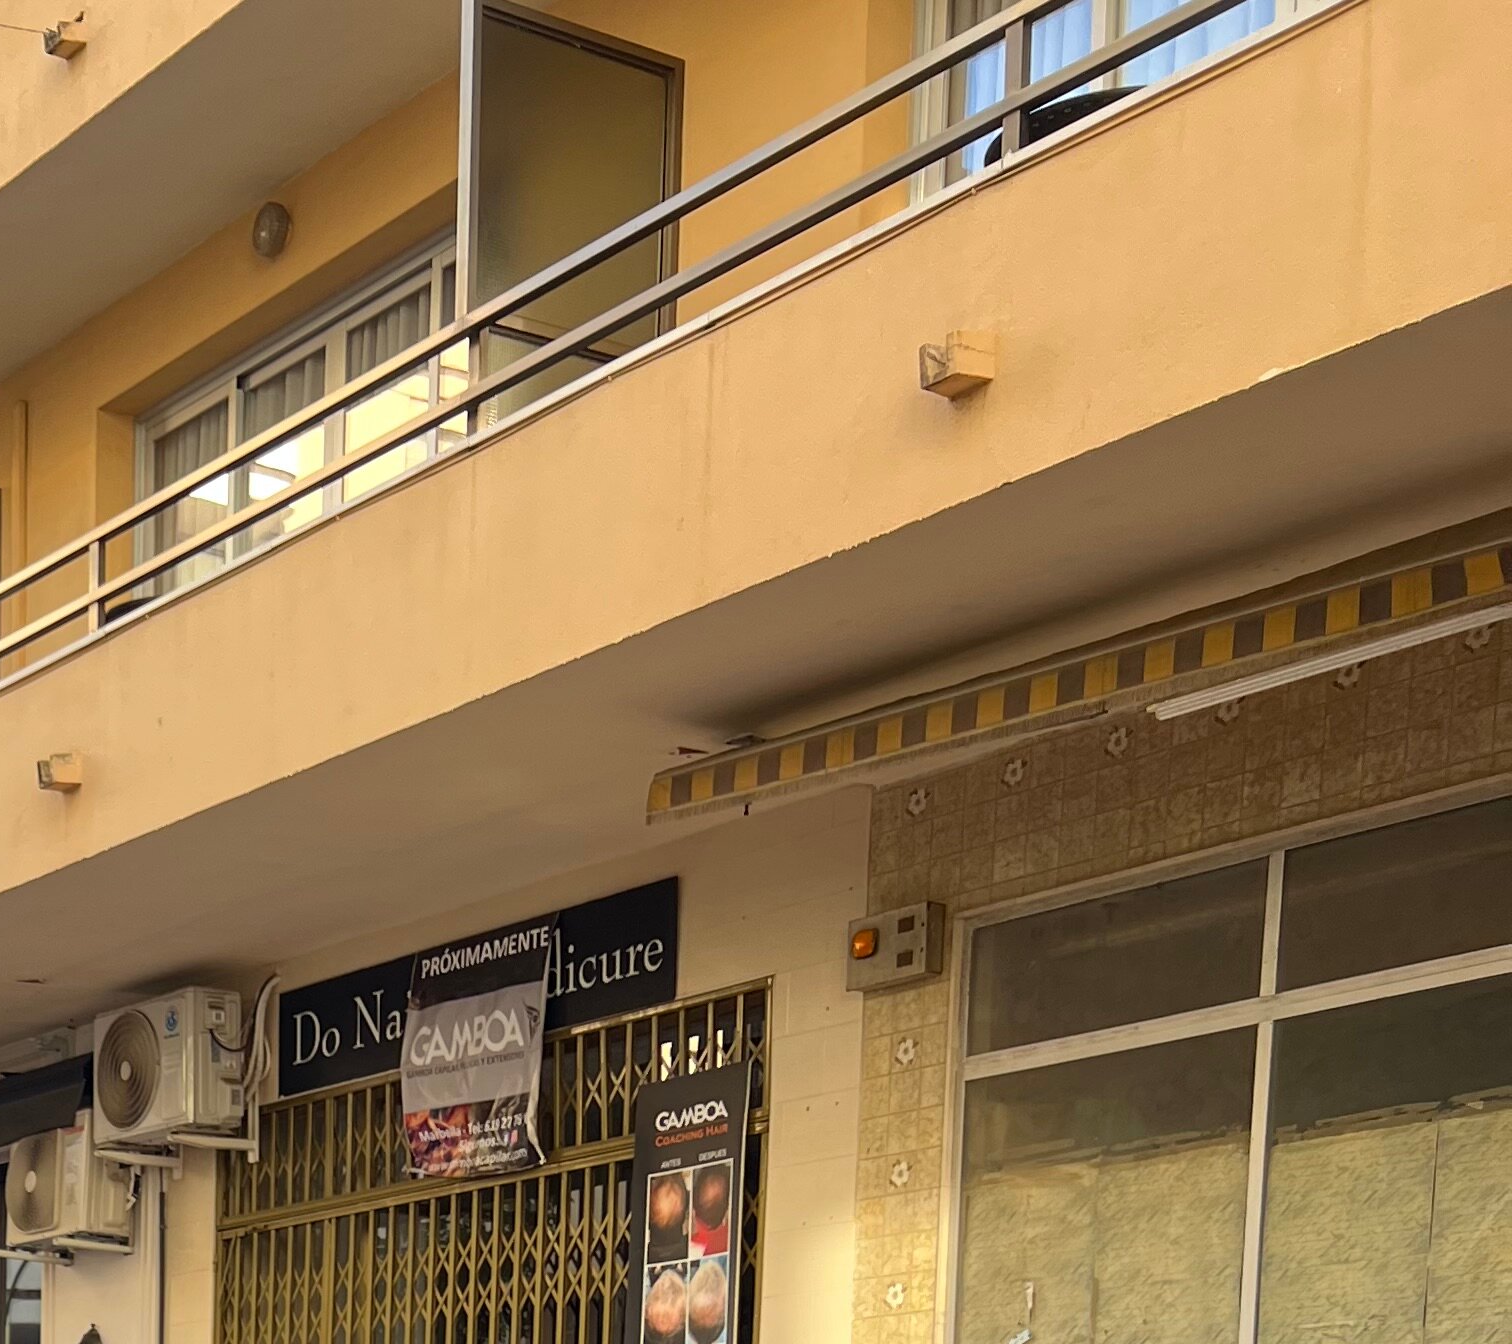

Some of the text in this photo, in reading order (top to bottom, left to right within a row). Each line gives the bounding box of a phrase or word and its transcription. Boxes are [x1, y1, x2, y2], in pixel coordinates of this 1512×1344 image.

[420, 925, 550, 980] PRÓXIMAMENTE
[292, 1010, 341, 1066] Do
[352, 989, 411, 1051] Na
[409, 1008, 525, 1067] GAMBOA
[654, 1100, 729, 1132] GAMBOA
